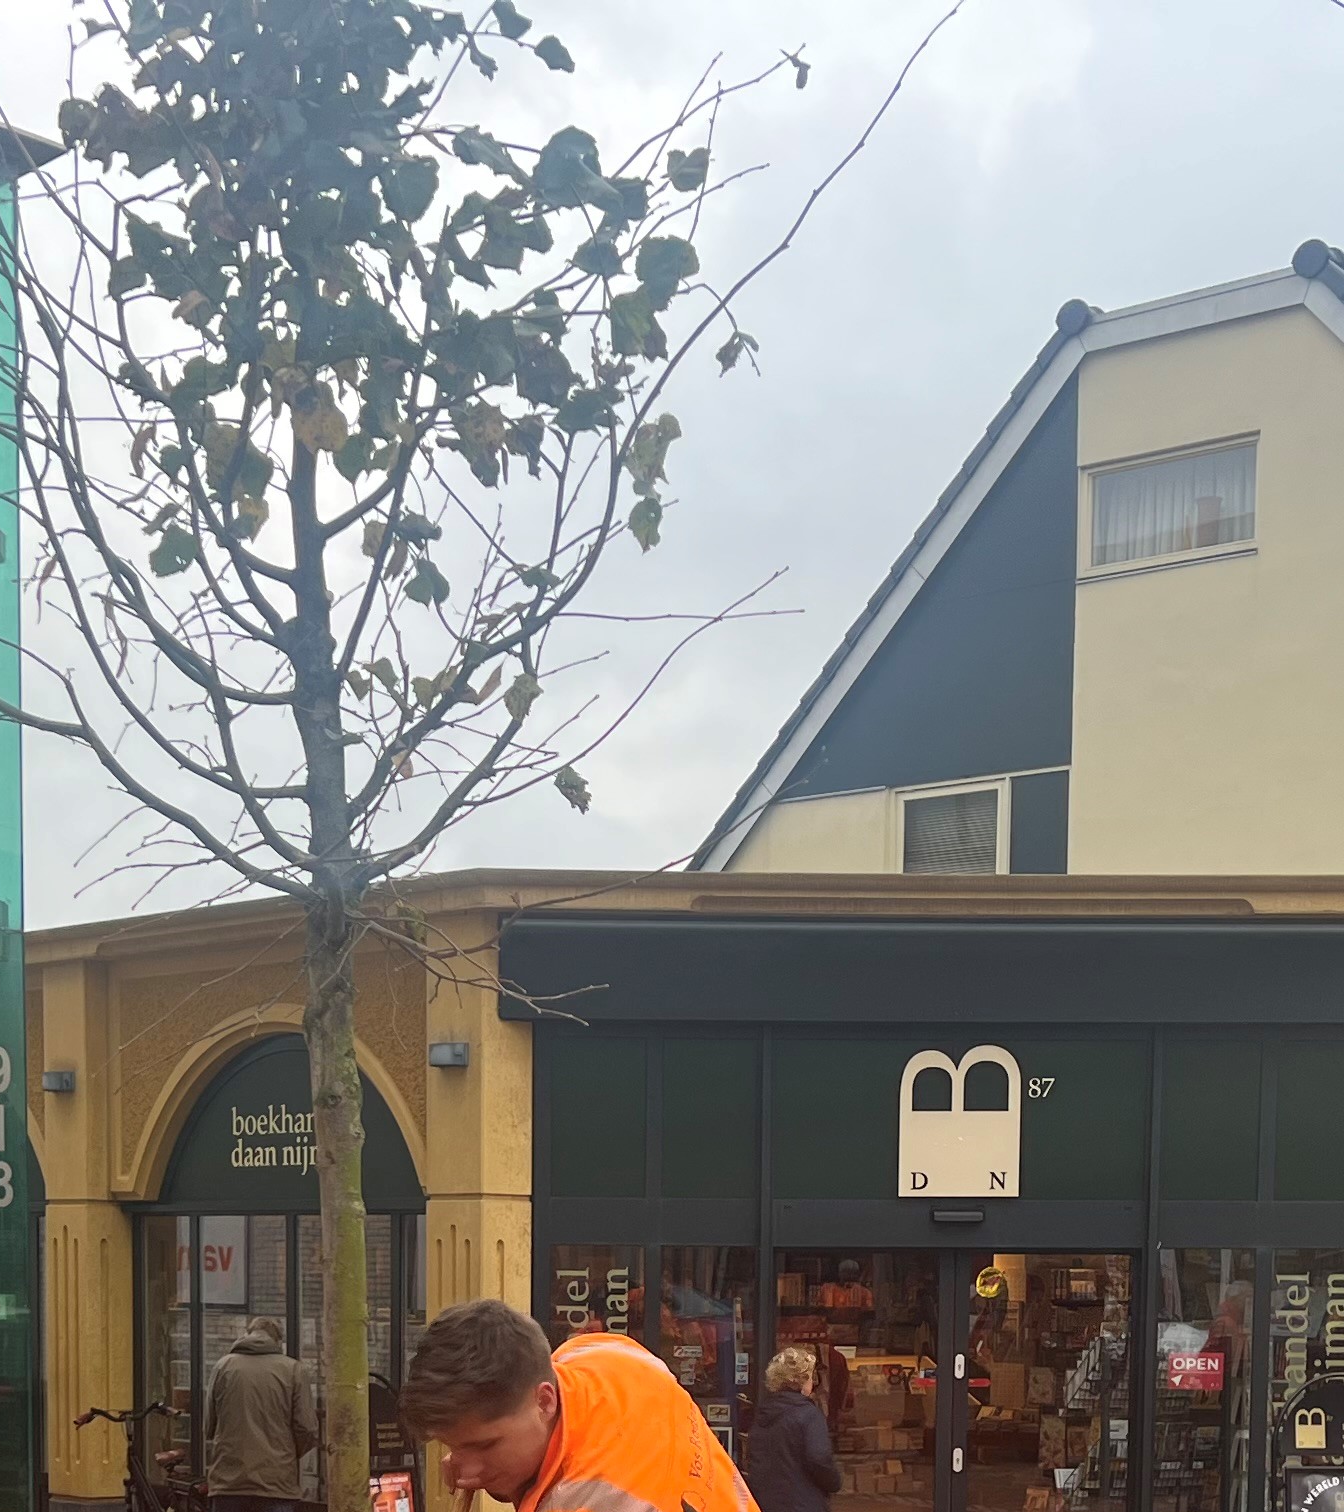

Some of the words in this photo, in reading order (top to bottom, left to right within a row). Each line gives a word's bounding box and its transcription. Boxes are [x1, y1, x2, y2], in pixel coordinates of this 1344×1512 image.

[1027, 1077, 1055, 1099] 87
[231, 1138, 277, 1168] daan
[282, 1136, 318, 1176] nij
[910, 1172, 928, 1190] D
[989, 1171, 1007, 1190] N
[1172, 1357, 1219, 1371] OPEN
[1303, 1476, 1340, 1506] WERELD
